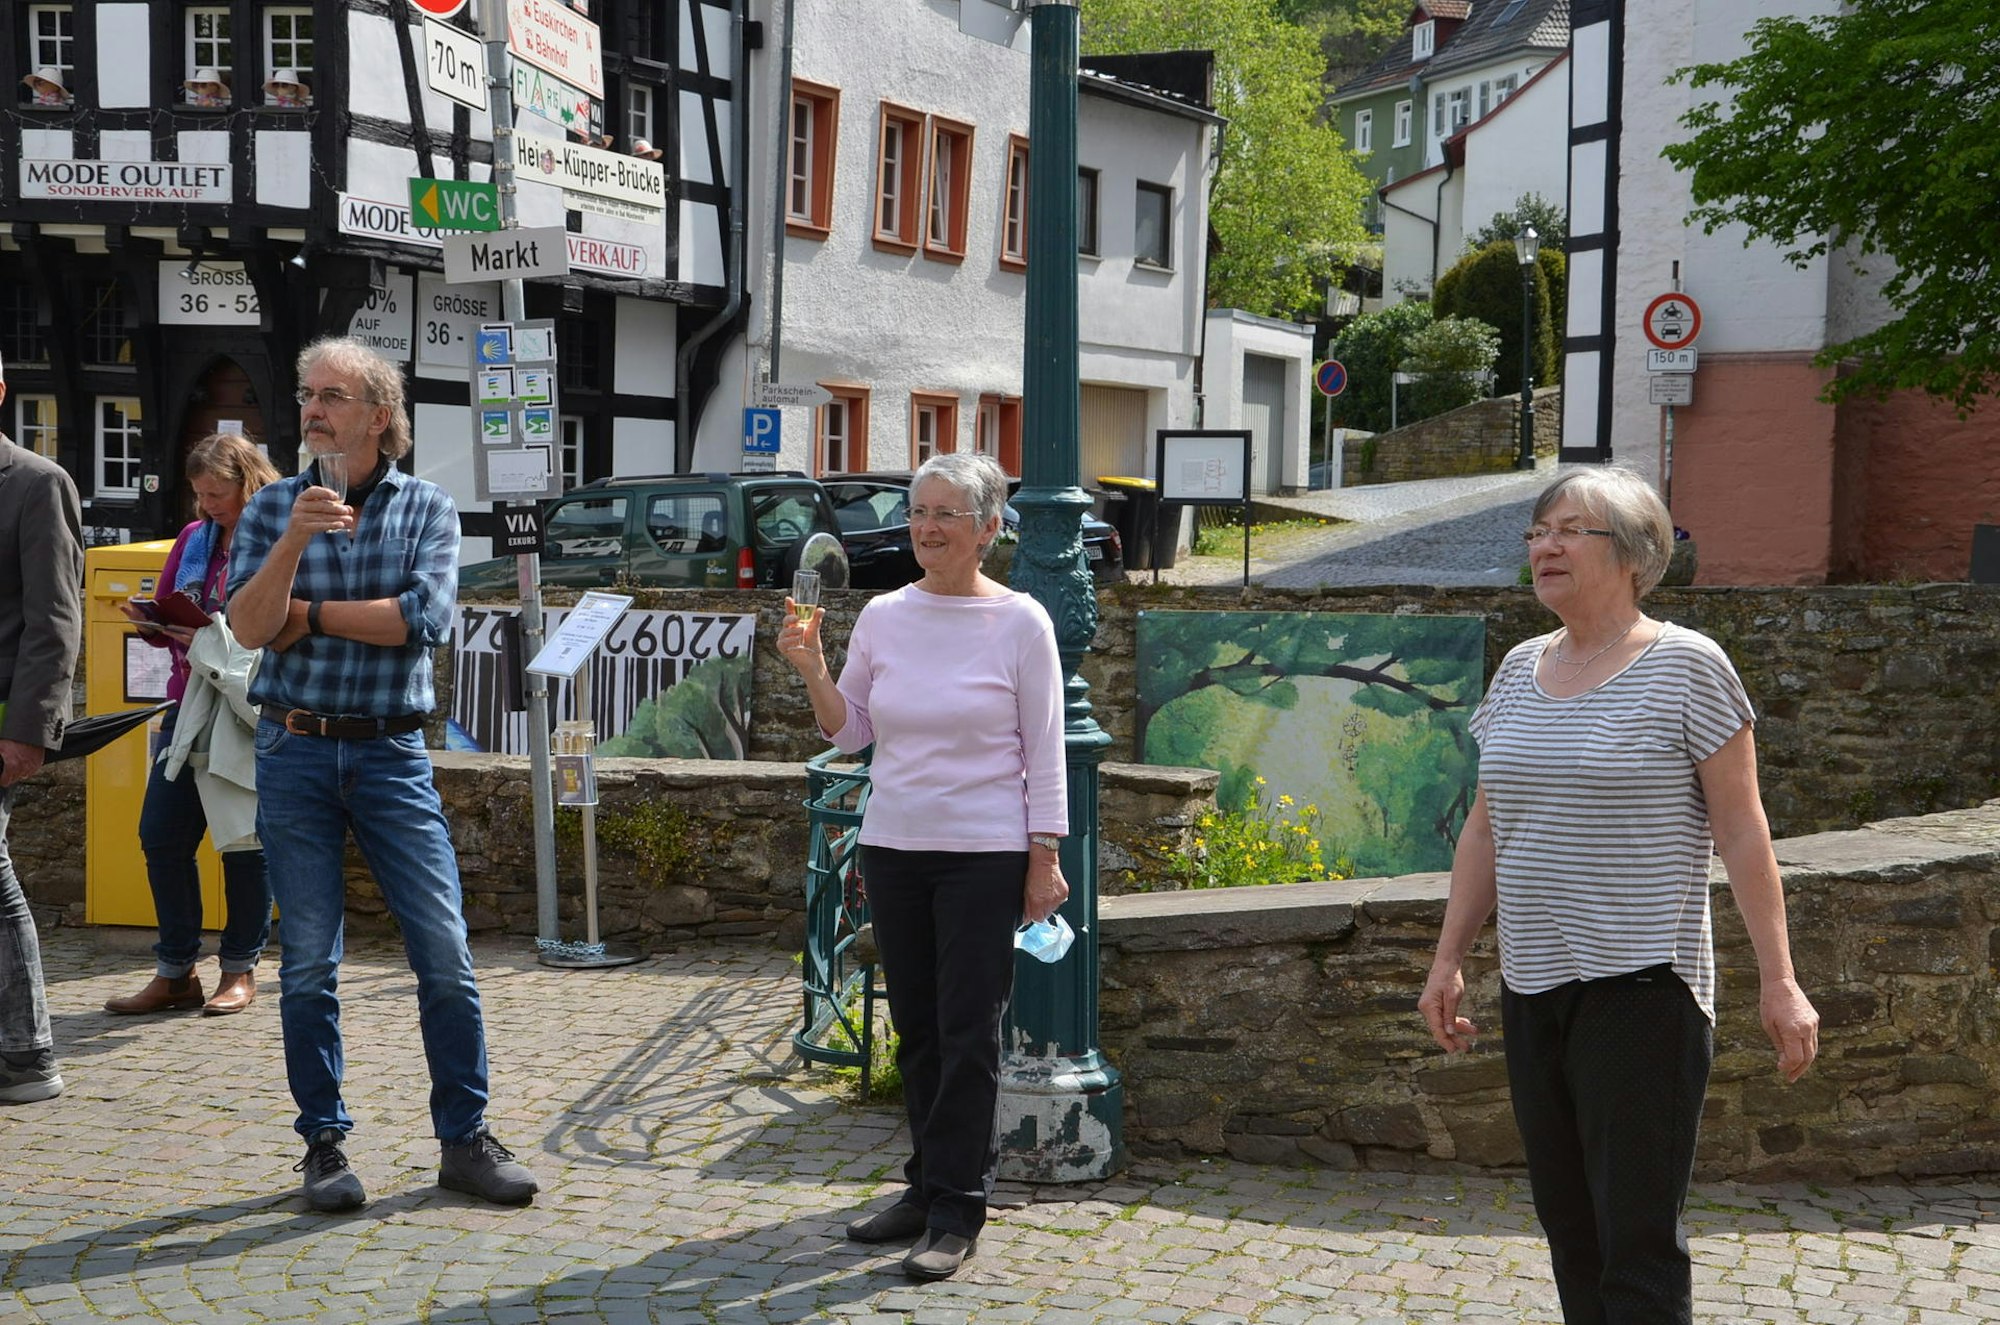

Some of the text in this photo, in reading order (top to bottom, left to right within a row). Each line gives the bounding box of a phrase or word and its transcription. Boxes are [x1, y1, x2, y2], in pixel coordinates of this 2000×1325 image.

[533, 0, 578, 46] Euskirchen
[535, 33, 569, 70] Bahnhof
[435, 39, 477, 90] 70 m
[517, 67, 528, 99] F1
[27, 163, 225, 187] MODE OUTLET
[47, 185, 204, 199] SONDERVERKAUF
[442, 189, 491, 222] WC
[348, 202, 409, 235] MODE
[471, 239, 540, 272] Markt
[179, 293, 209, 313] 36
[234, 294, 261, 313] 52
[433, 293, 488, 317] GRÖSSE
[355, 317, 381, 330] AUF
[427, 321, 450, 345] 36
[1654, 351, 1688, 364] 150 m
[762, 384, 817, 396] Parkschein-
[762, 394, 799, 404] automat
[752, 413, 773, 446] P
[504, 513, 538, 533] VIA
[507, 535, 537, 547] EXKURS
